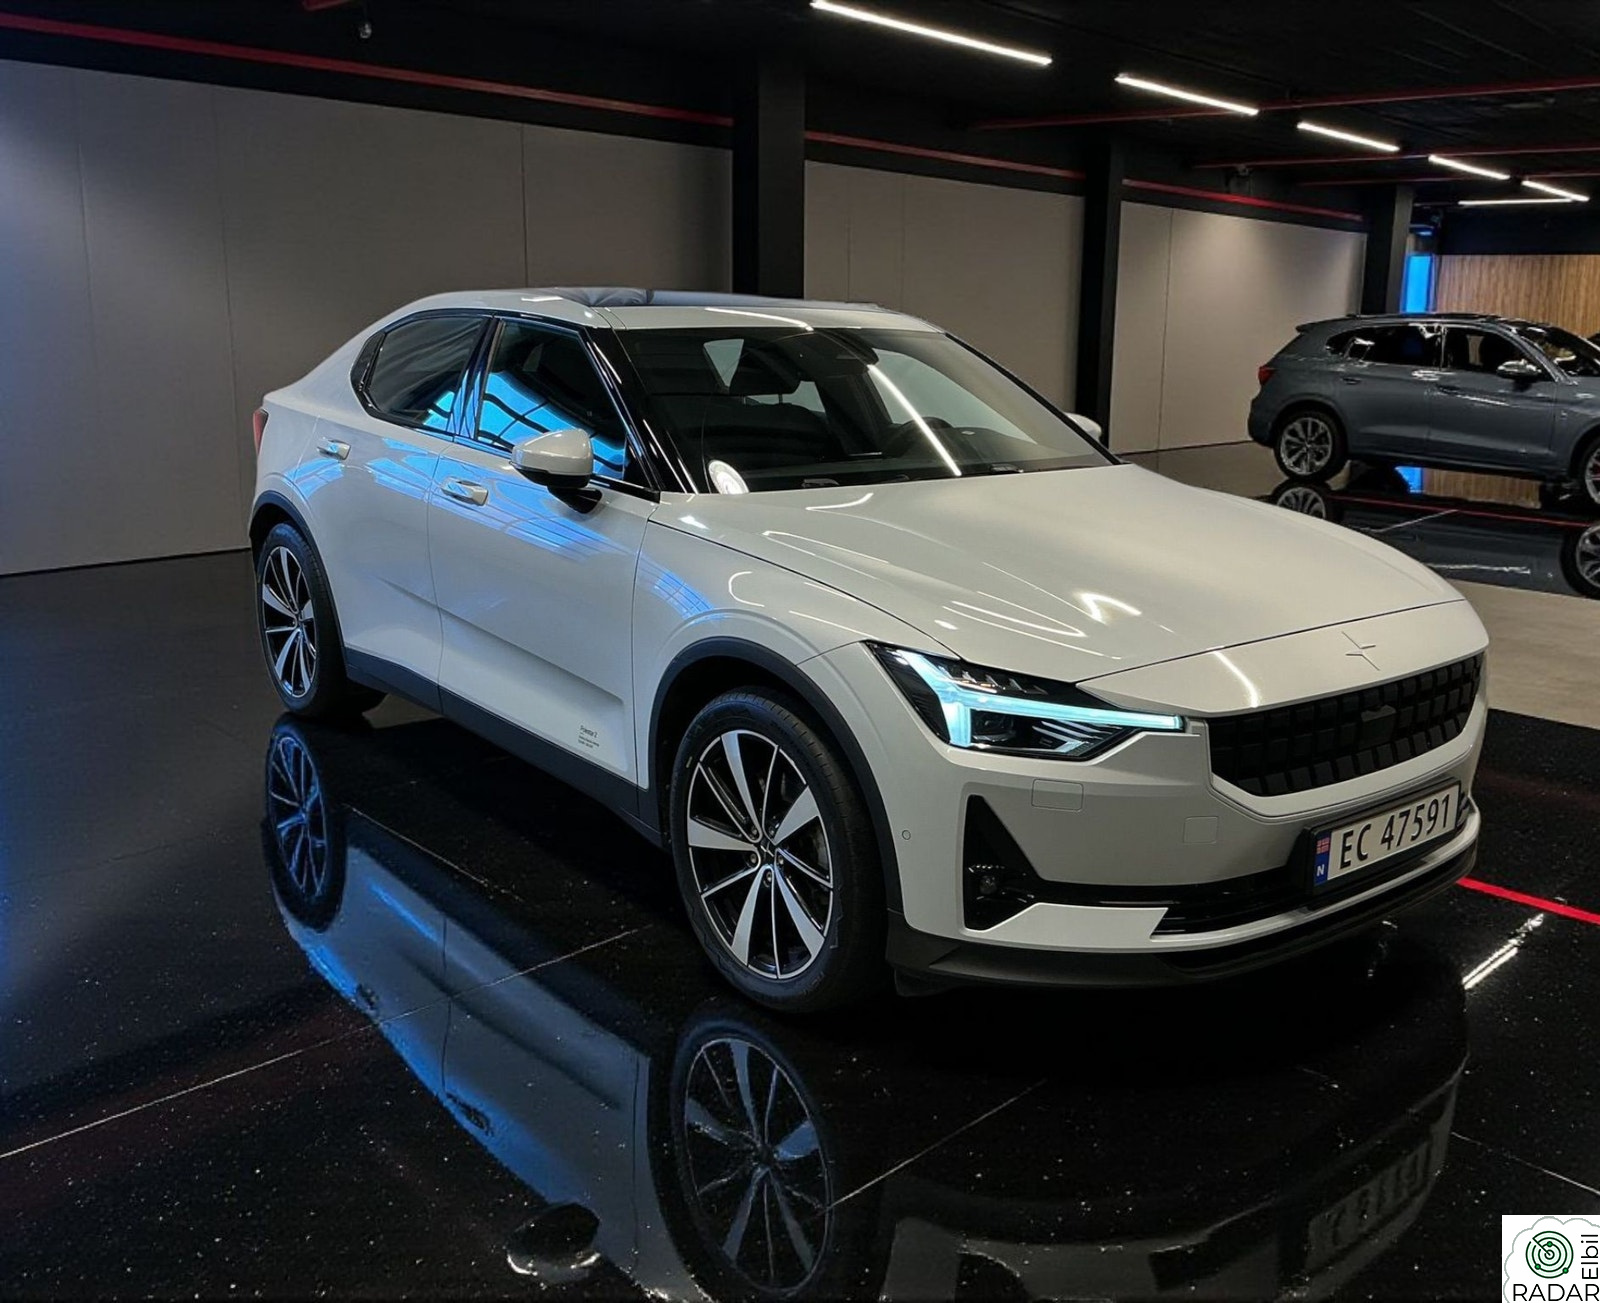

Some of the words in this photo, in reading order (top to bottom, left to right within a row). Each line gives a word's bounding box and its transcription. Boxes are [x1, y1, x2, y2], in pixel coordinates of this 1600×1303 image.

[1340, 823, 1372, 869] EC
[1380, 794, 1450, 850] 47591
[1316, 864, 1325, 876] N
